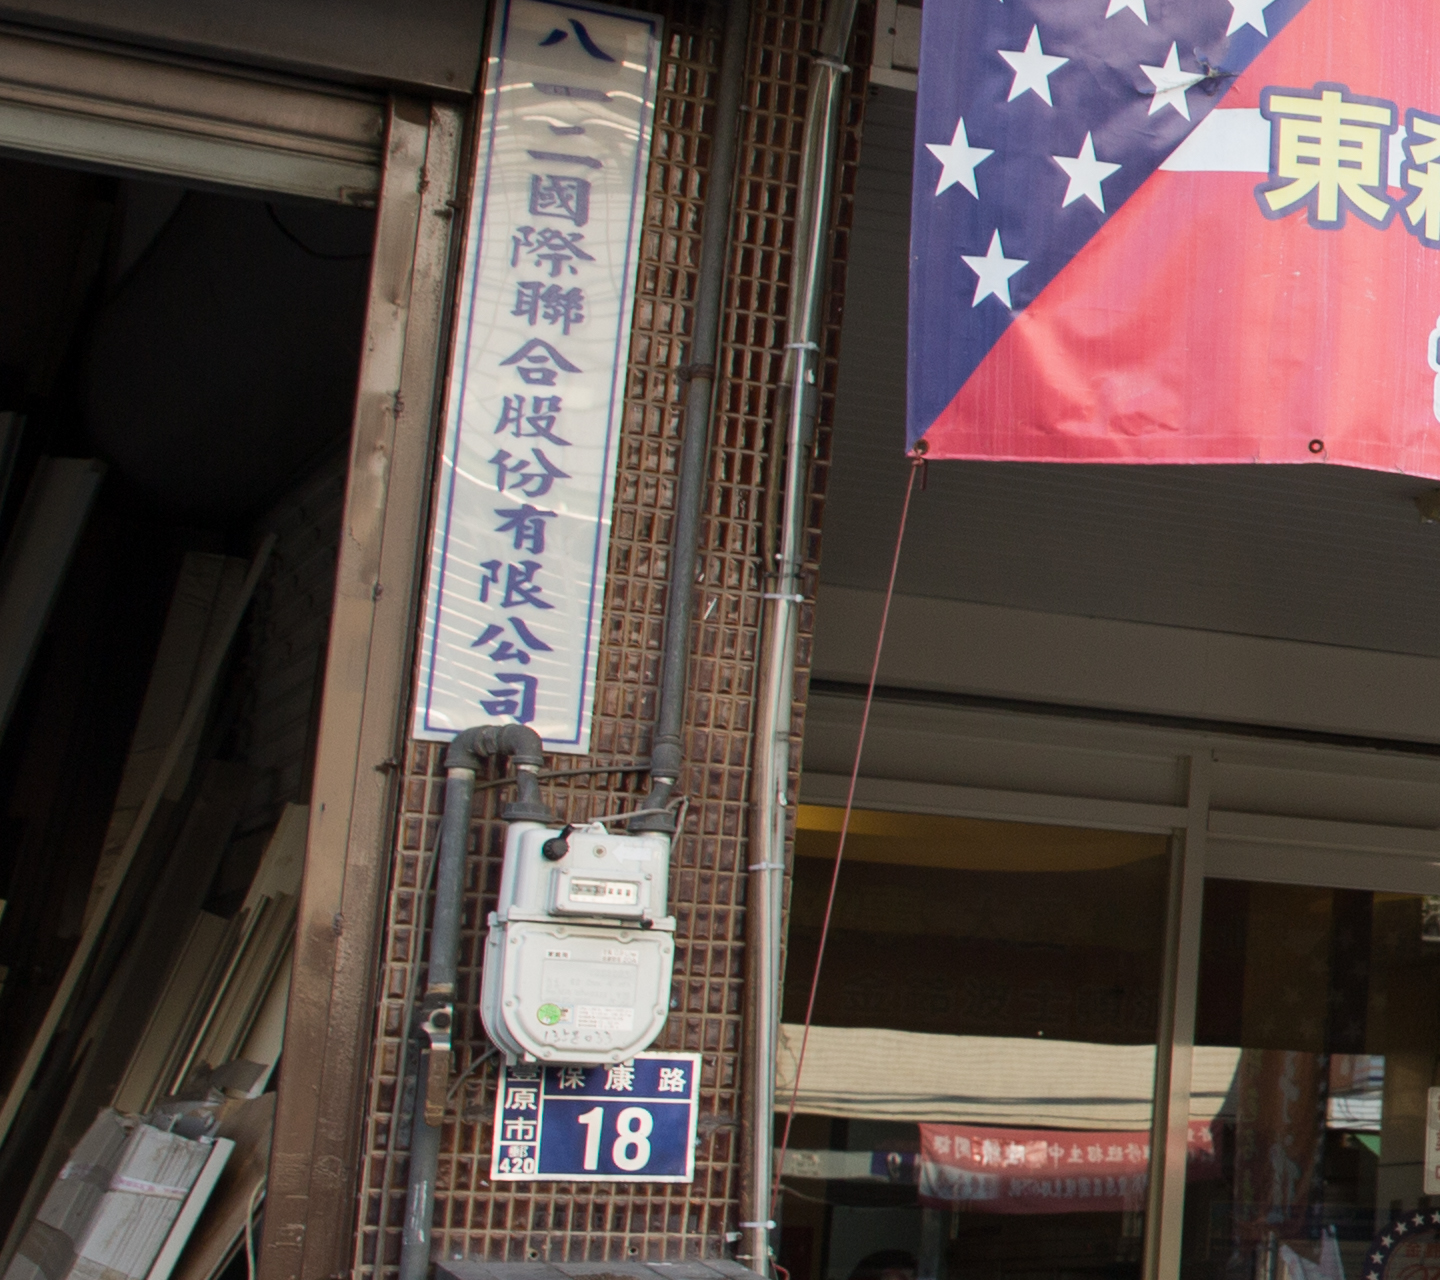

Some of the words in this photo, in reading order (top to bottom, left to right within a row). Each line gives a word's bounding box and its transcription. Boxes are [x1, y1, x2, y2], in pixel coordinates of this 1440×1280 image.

[470, 16, 615, 725] 八一二國際聯合股份有限公司
[557, 1060, 687, 1092] 保康路
[577, 1106, 655, 1171] 18
[499, 1157, 535, 1174] 420
